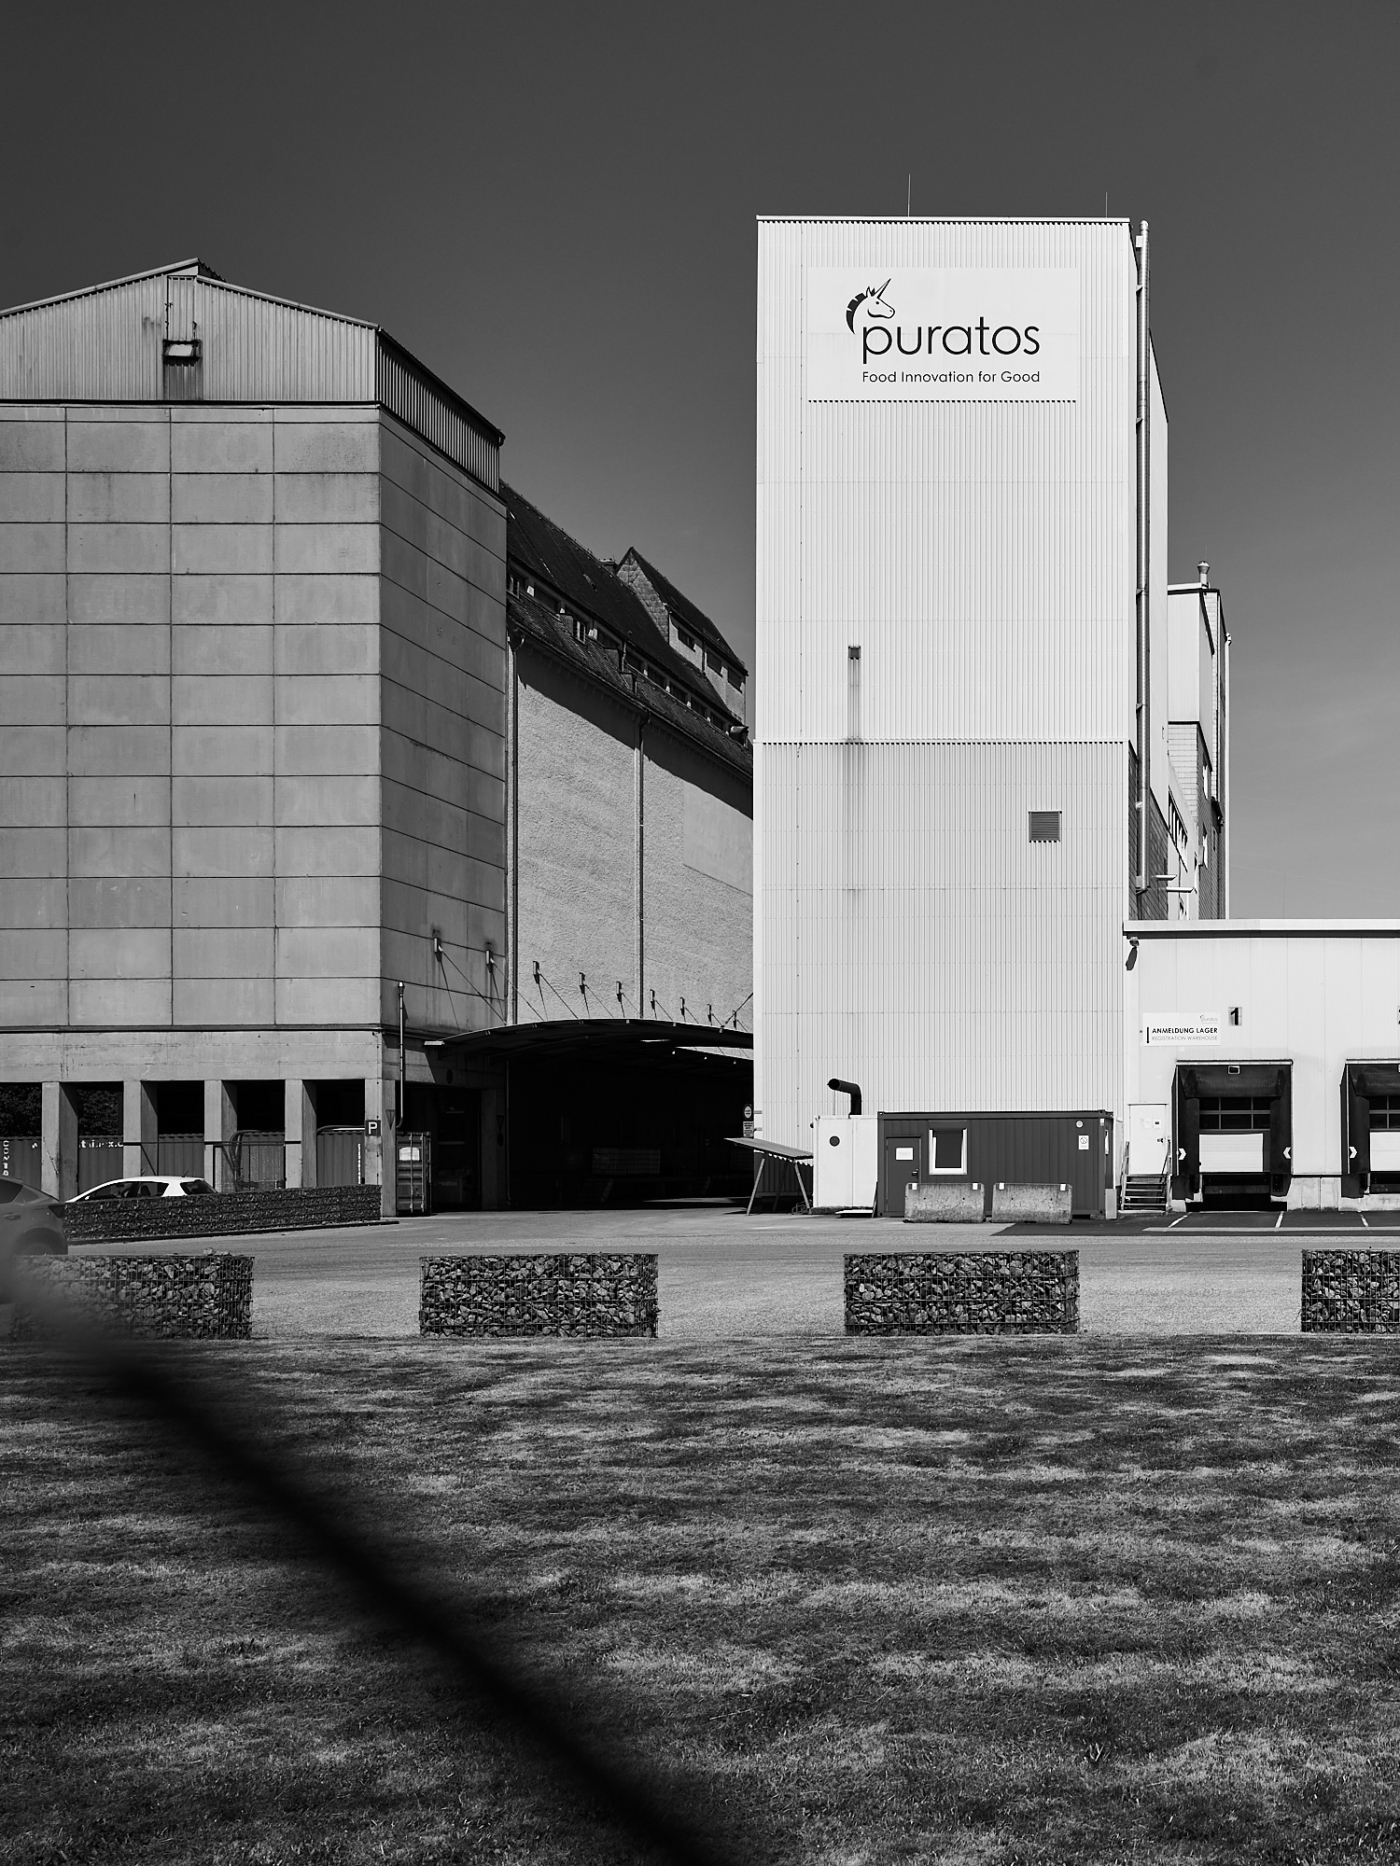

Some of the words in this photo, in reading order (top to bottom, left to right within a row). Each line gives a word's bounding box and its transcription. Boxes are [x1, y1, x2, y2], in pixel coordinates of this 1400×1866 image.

[862, 316, 1041, 365] puratos
[862, 371, 897, 383] Food
[901, 371, 974, 383] Innovation
[978, 371, 997, 383] for
[1000, 371, 1041, 383] Good
[1230, 1007, 1239, 1025] 1
[368, 1121, 378, 1135] P
